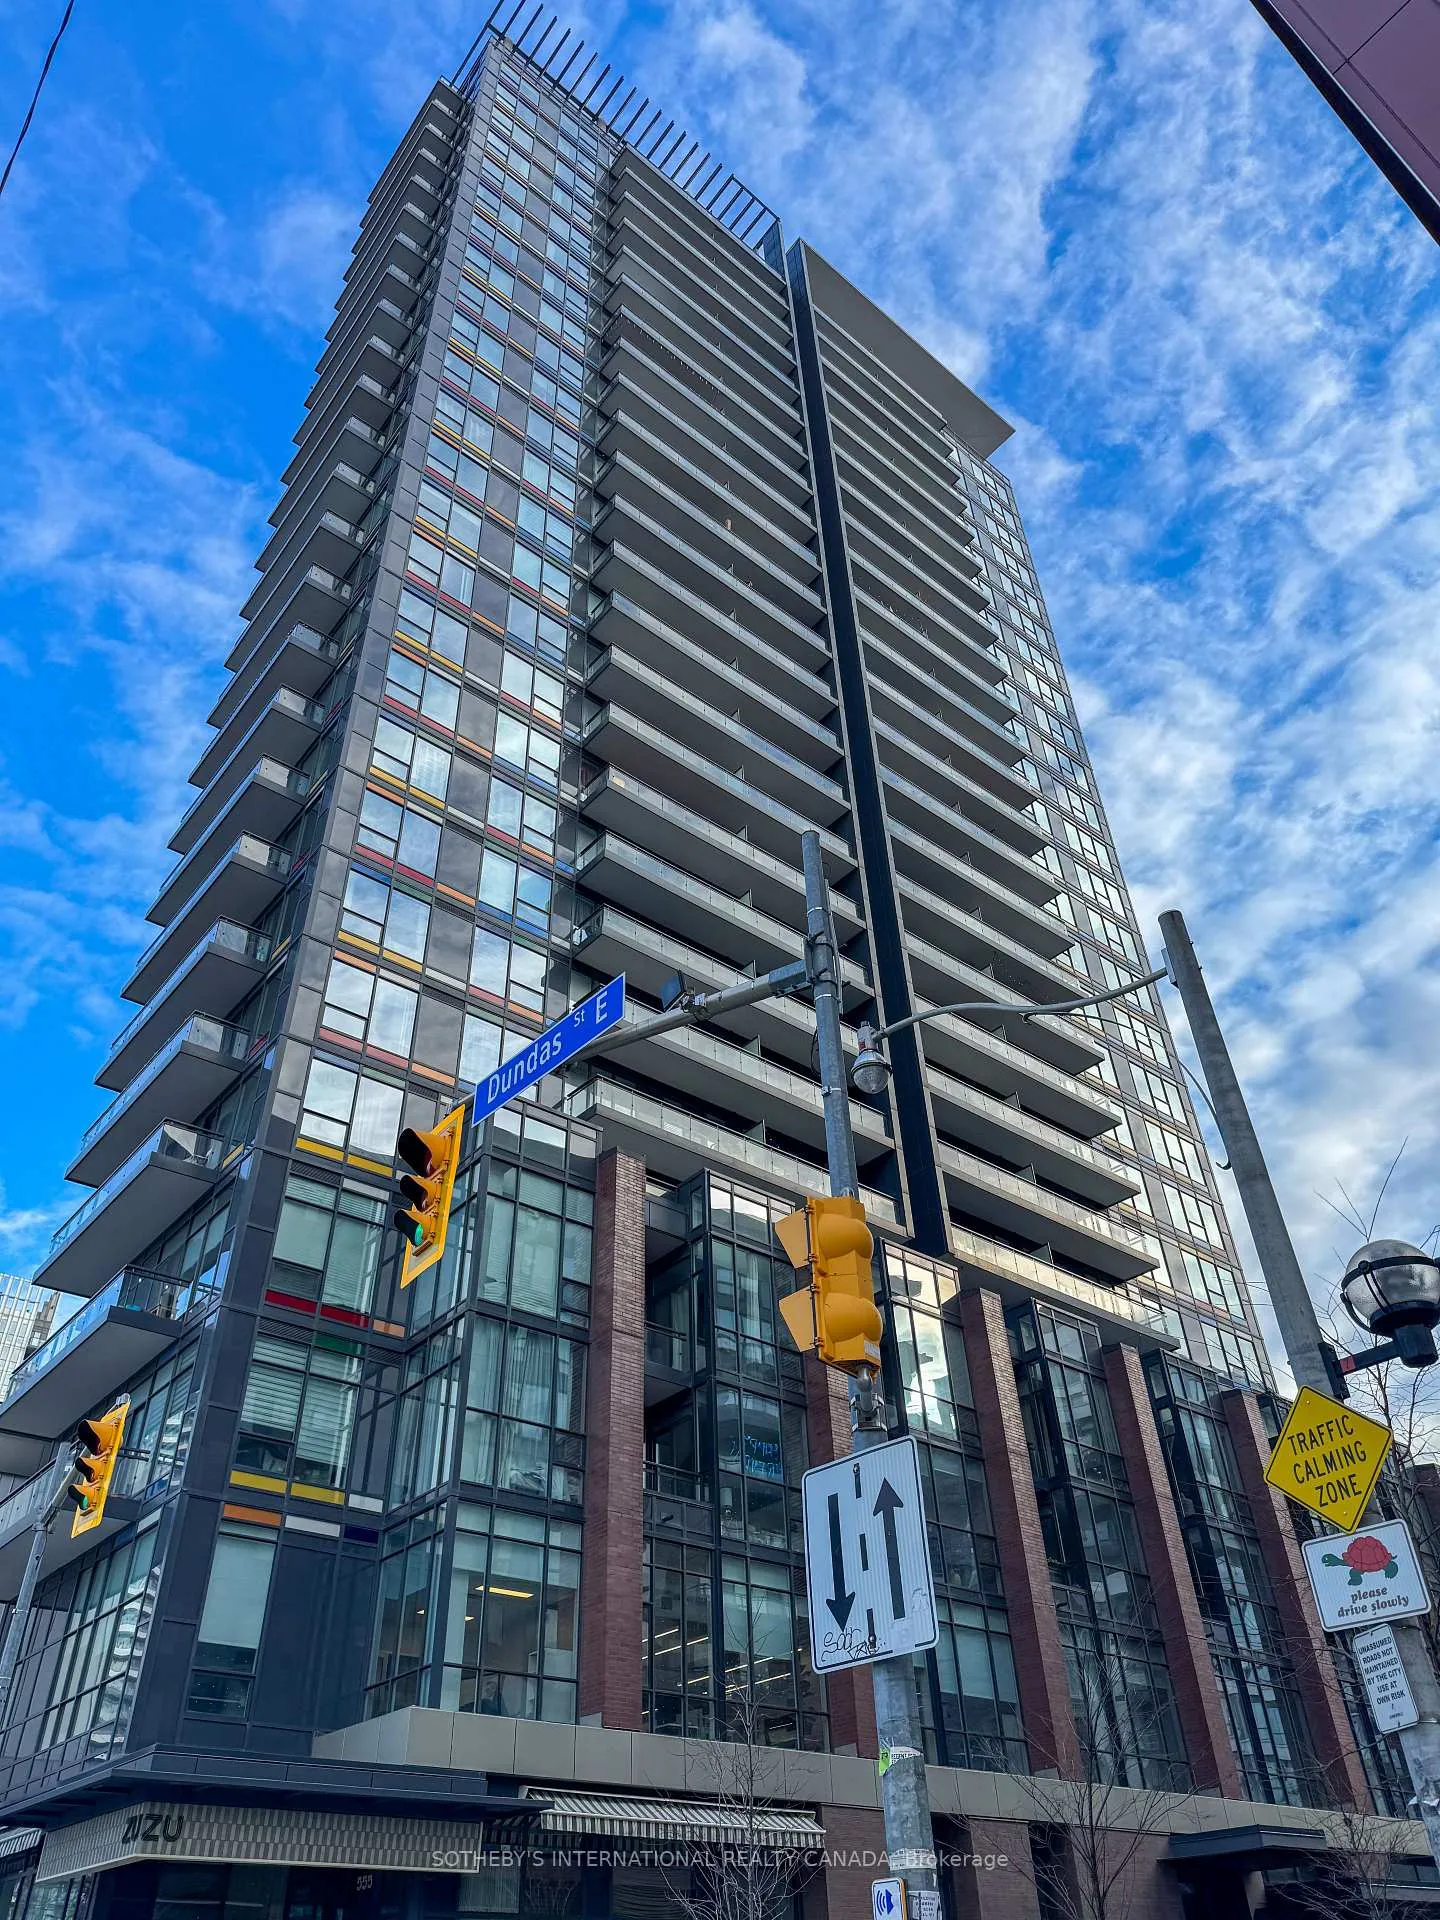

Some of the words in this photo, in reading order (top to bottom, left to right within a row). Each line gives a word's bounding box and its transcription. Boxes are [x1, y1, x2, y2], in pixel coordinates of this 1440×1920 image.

[487, 1031, 562, 1104] Dundas
[573, 1009, 585, 1027] St
[595, 991, 608, 1024] E
[1287, 1414, 1354, 1456] TRAFFIC
[1293, 1440, 1367, 1484] CALMING
[1315, 1473, 1362, 1508] ZONE
[1351, 1587, 1388, 1604] please
[1337, 1604, 1368, 1617] drive
[1371, 1595, 1409, 1611] slowly
[1358, 1636, 1392, 1655] UNASSUMED
[1362, 1652, 1381, 1664] ROADS
[1381, 1647, 1394, 1658] NOT
[1364, 1657, 1398, 1675] MAINTAINED
[1367, 1677, 1375, 1685] BY
[1376, 1672, 1388, 1682] THE
[1388, 1667, 1401, 1678] CITY
[1377, 1683, 1389, 1693] USE
[1390, 1680, 1397, 1689] AT
[1376, 1694, 1391, 1704] OWN
[1390, 1689, 1406, 1701] RISK
